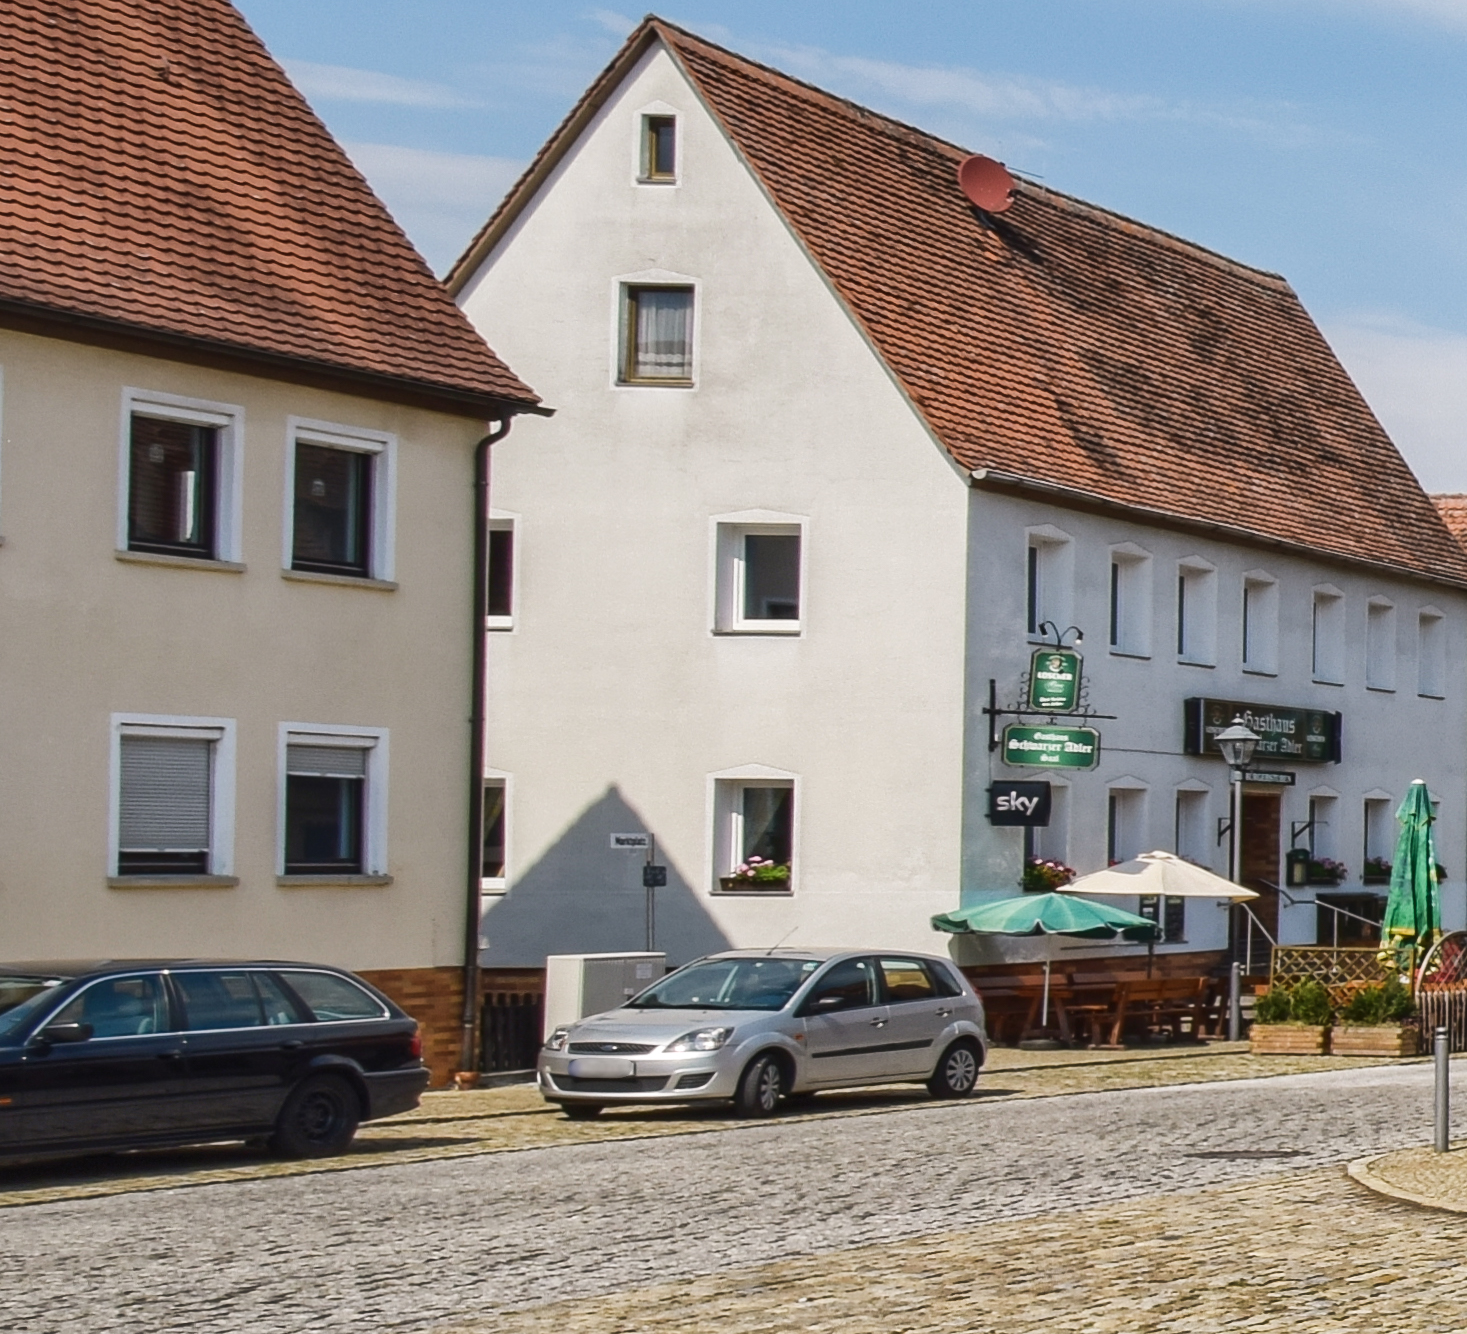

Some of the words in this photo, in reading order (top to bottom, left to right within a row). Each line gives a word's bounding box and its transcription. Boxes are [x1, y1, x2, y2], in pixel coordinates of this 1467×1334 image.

[1243, 710, 1296, 734] Gasthaus
[1008, 739, 1062, 753] Schwarzer
[1064, 741, 1093, 754] Adler
[996, 790, 1040, 817] sky
